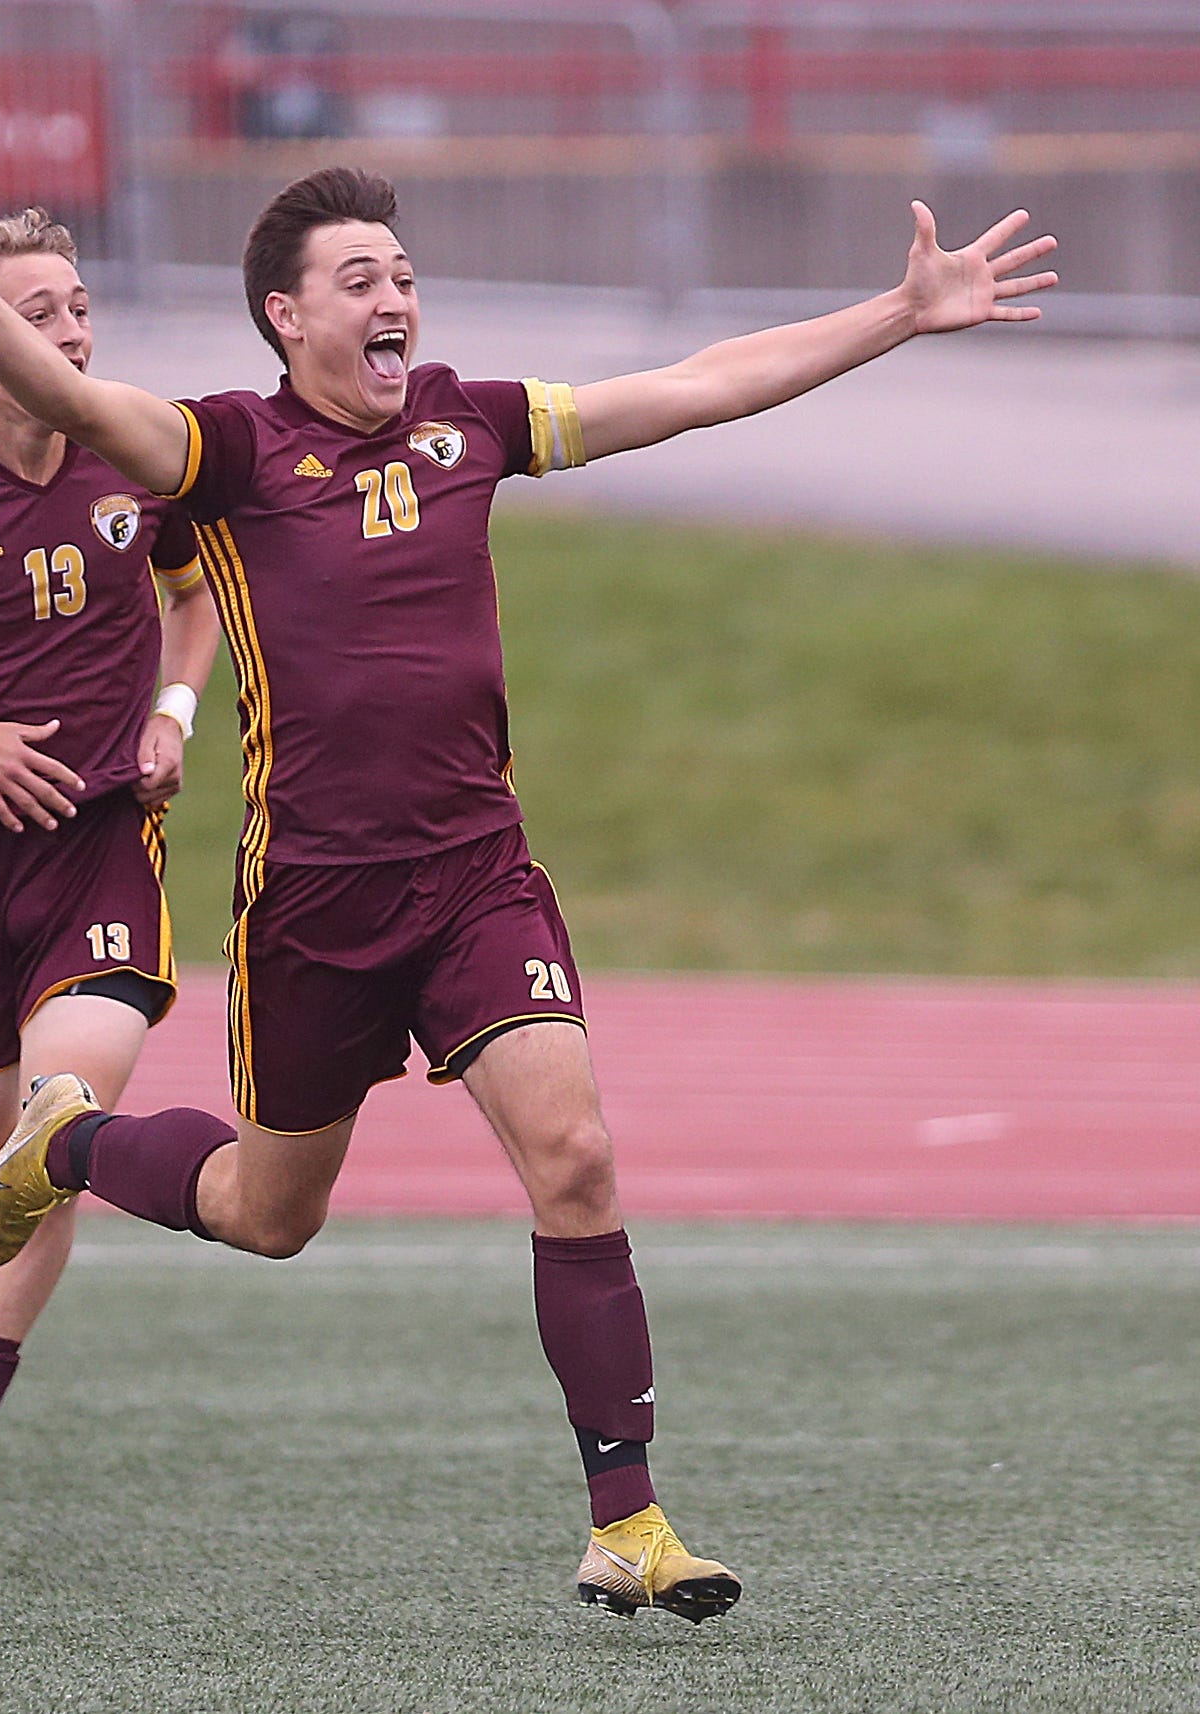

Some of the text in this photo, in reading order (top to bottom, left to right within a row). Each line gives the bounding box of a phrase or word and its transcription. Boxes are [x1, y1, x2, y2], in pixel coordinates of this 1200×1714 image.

[354, 461, 420, 539] 20
[23, 543, 86, 620] 13
[86, 922, 130, 961] 13
[525, 959, 572, 1003] 20
